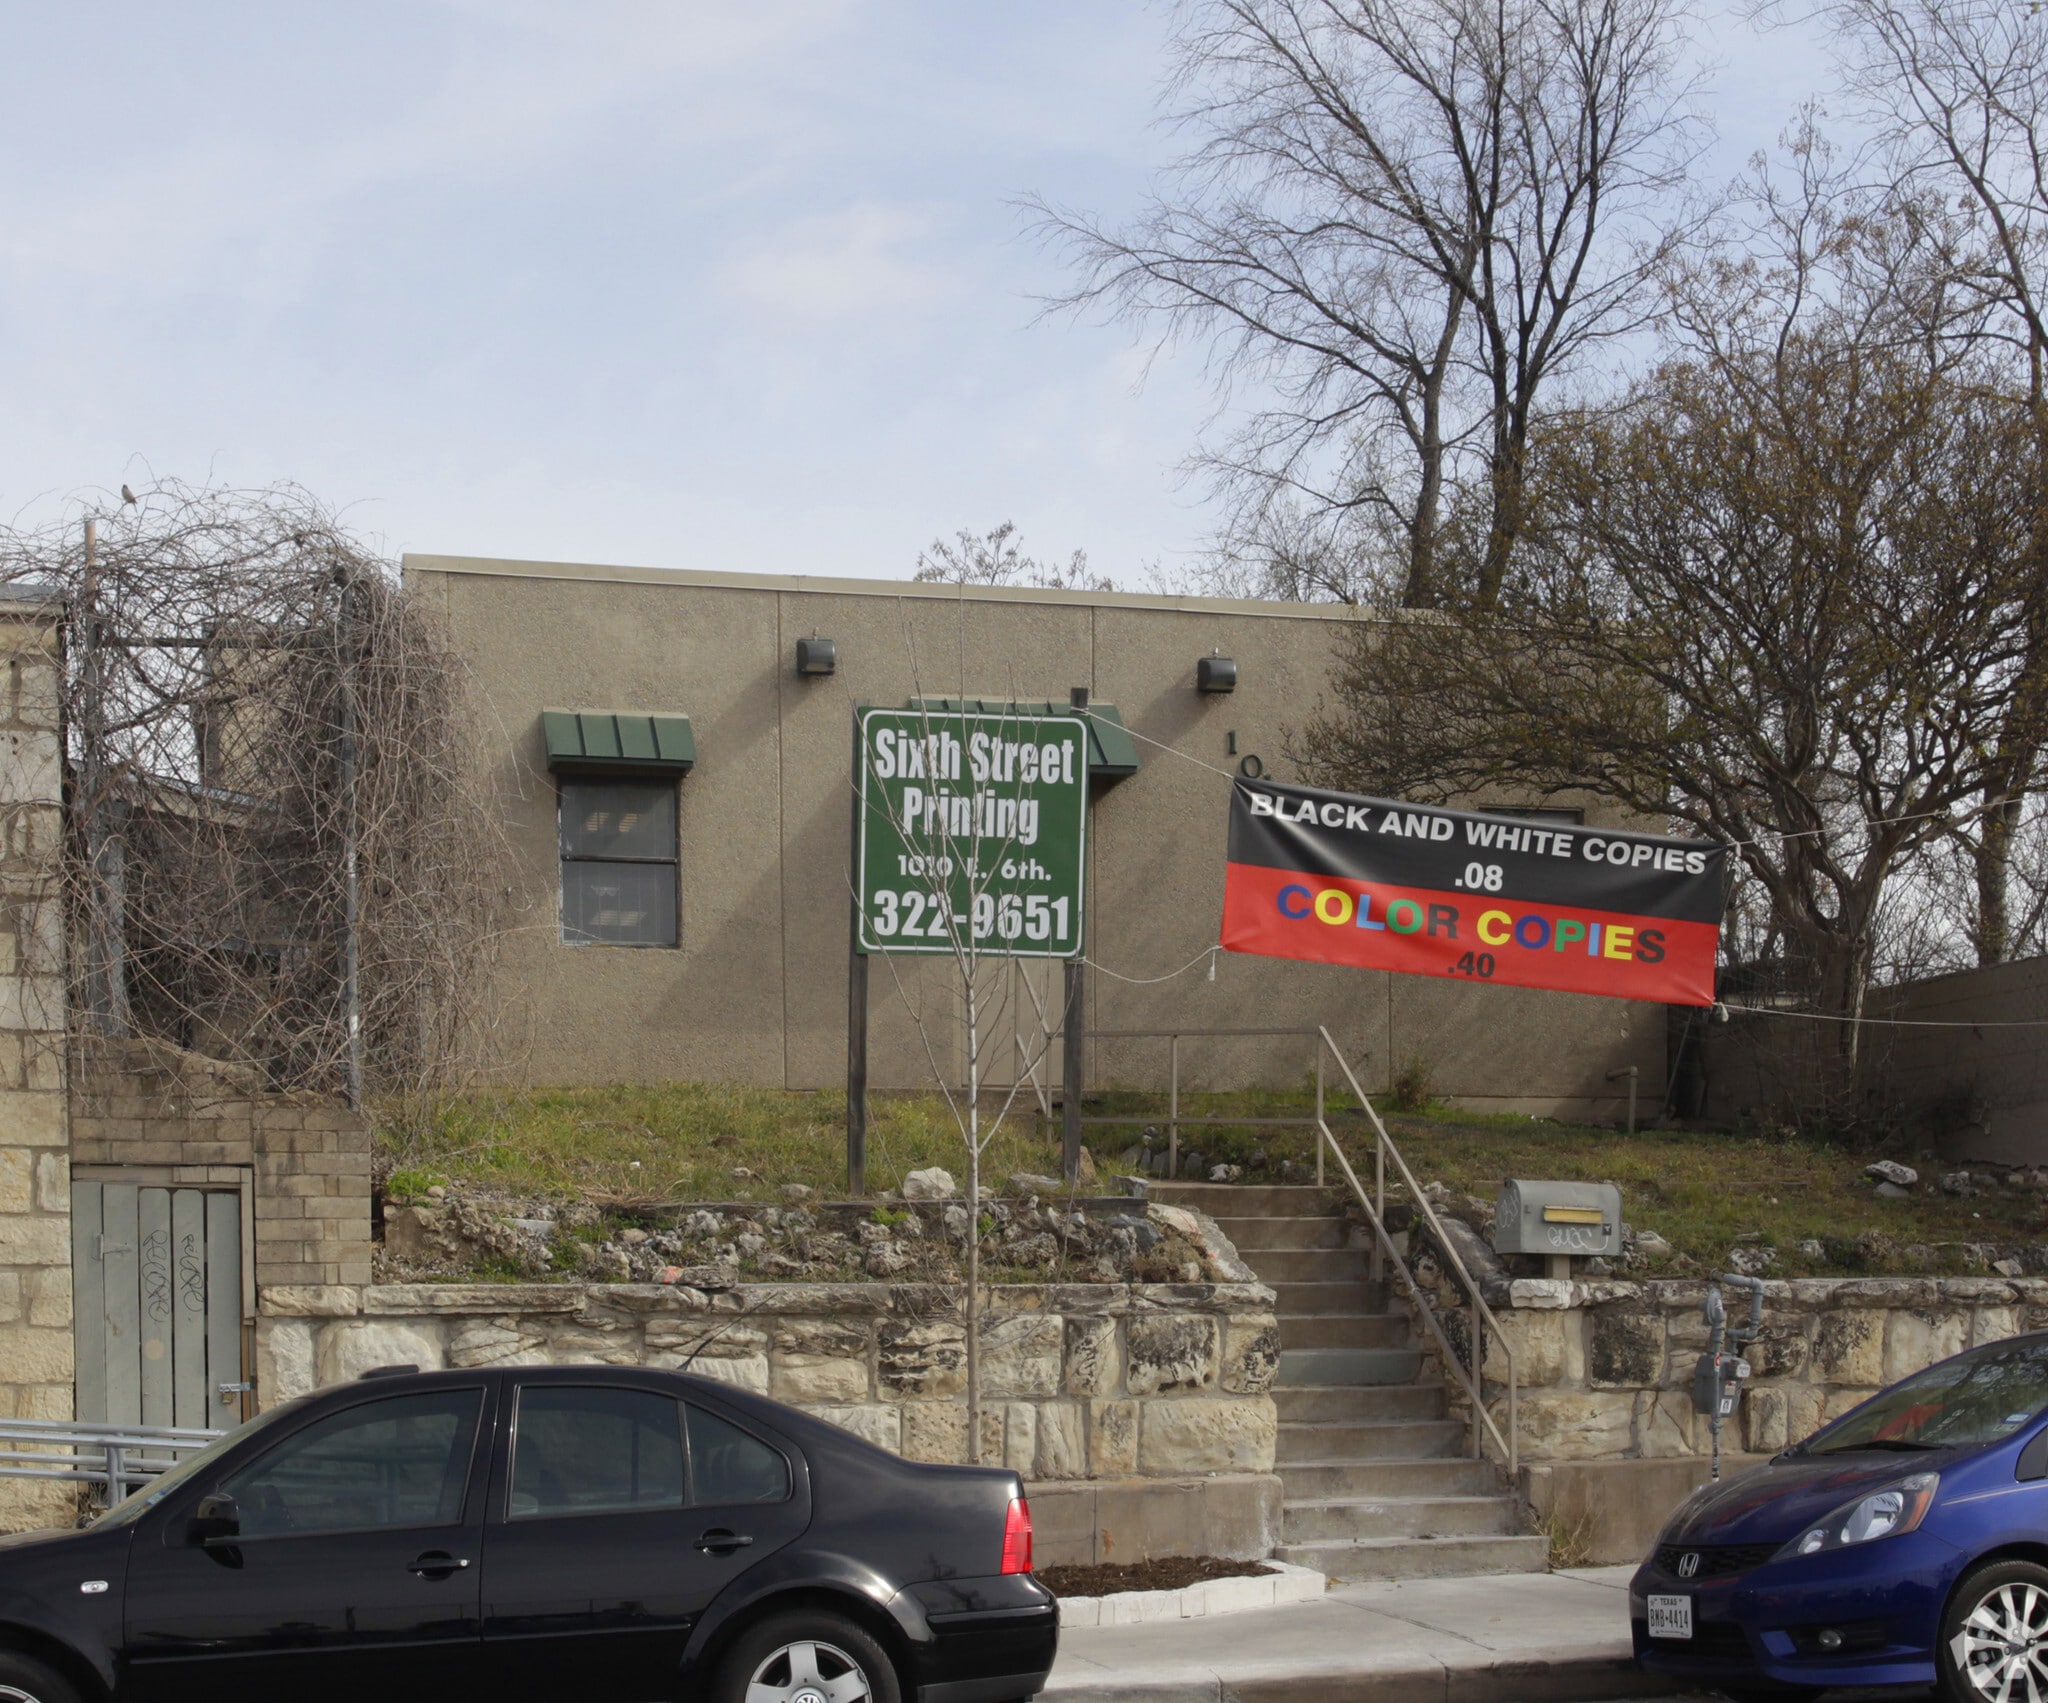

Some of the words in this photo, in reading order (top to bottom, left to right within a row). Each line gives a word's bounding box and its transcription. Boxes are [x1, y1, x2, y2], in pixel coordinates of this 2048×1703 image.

[875, 728, 961, 780] Sixth
[969, 732, 1075, 785] Street
[903, 786, 1039, 845] Printing
[1250, 792, 1371, 831] BLACK
[1379, 811, 1454, 841] AND
[1465, 821, 1574, 858] WHITE
[1582, 837, 1707, 874] COPIES
[1001, 858, 1052, 881] 6th.
[1455, 862, 1504, 892] .08
[873, 890, 1069, 940] 322-9651
[1277, 884, 1460, 939] COLOR
[1476, 910, 1666, 963] COPIES
[1447, 951, 1495, 977] .40
[1660, 1598, 1678, 1606] TEXAS
